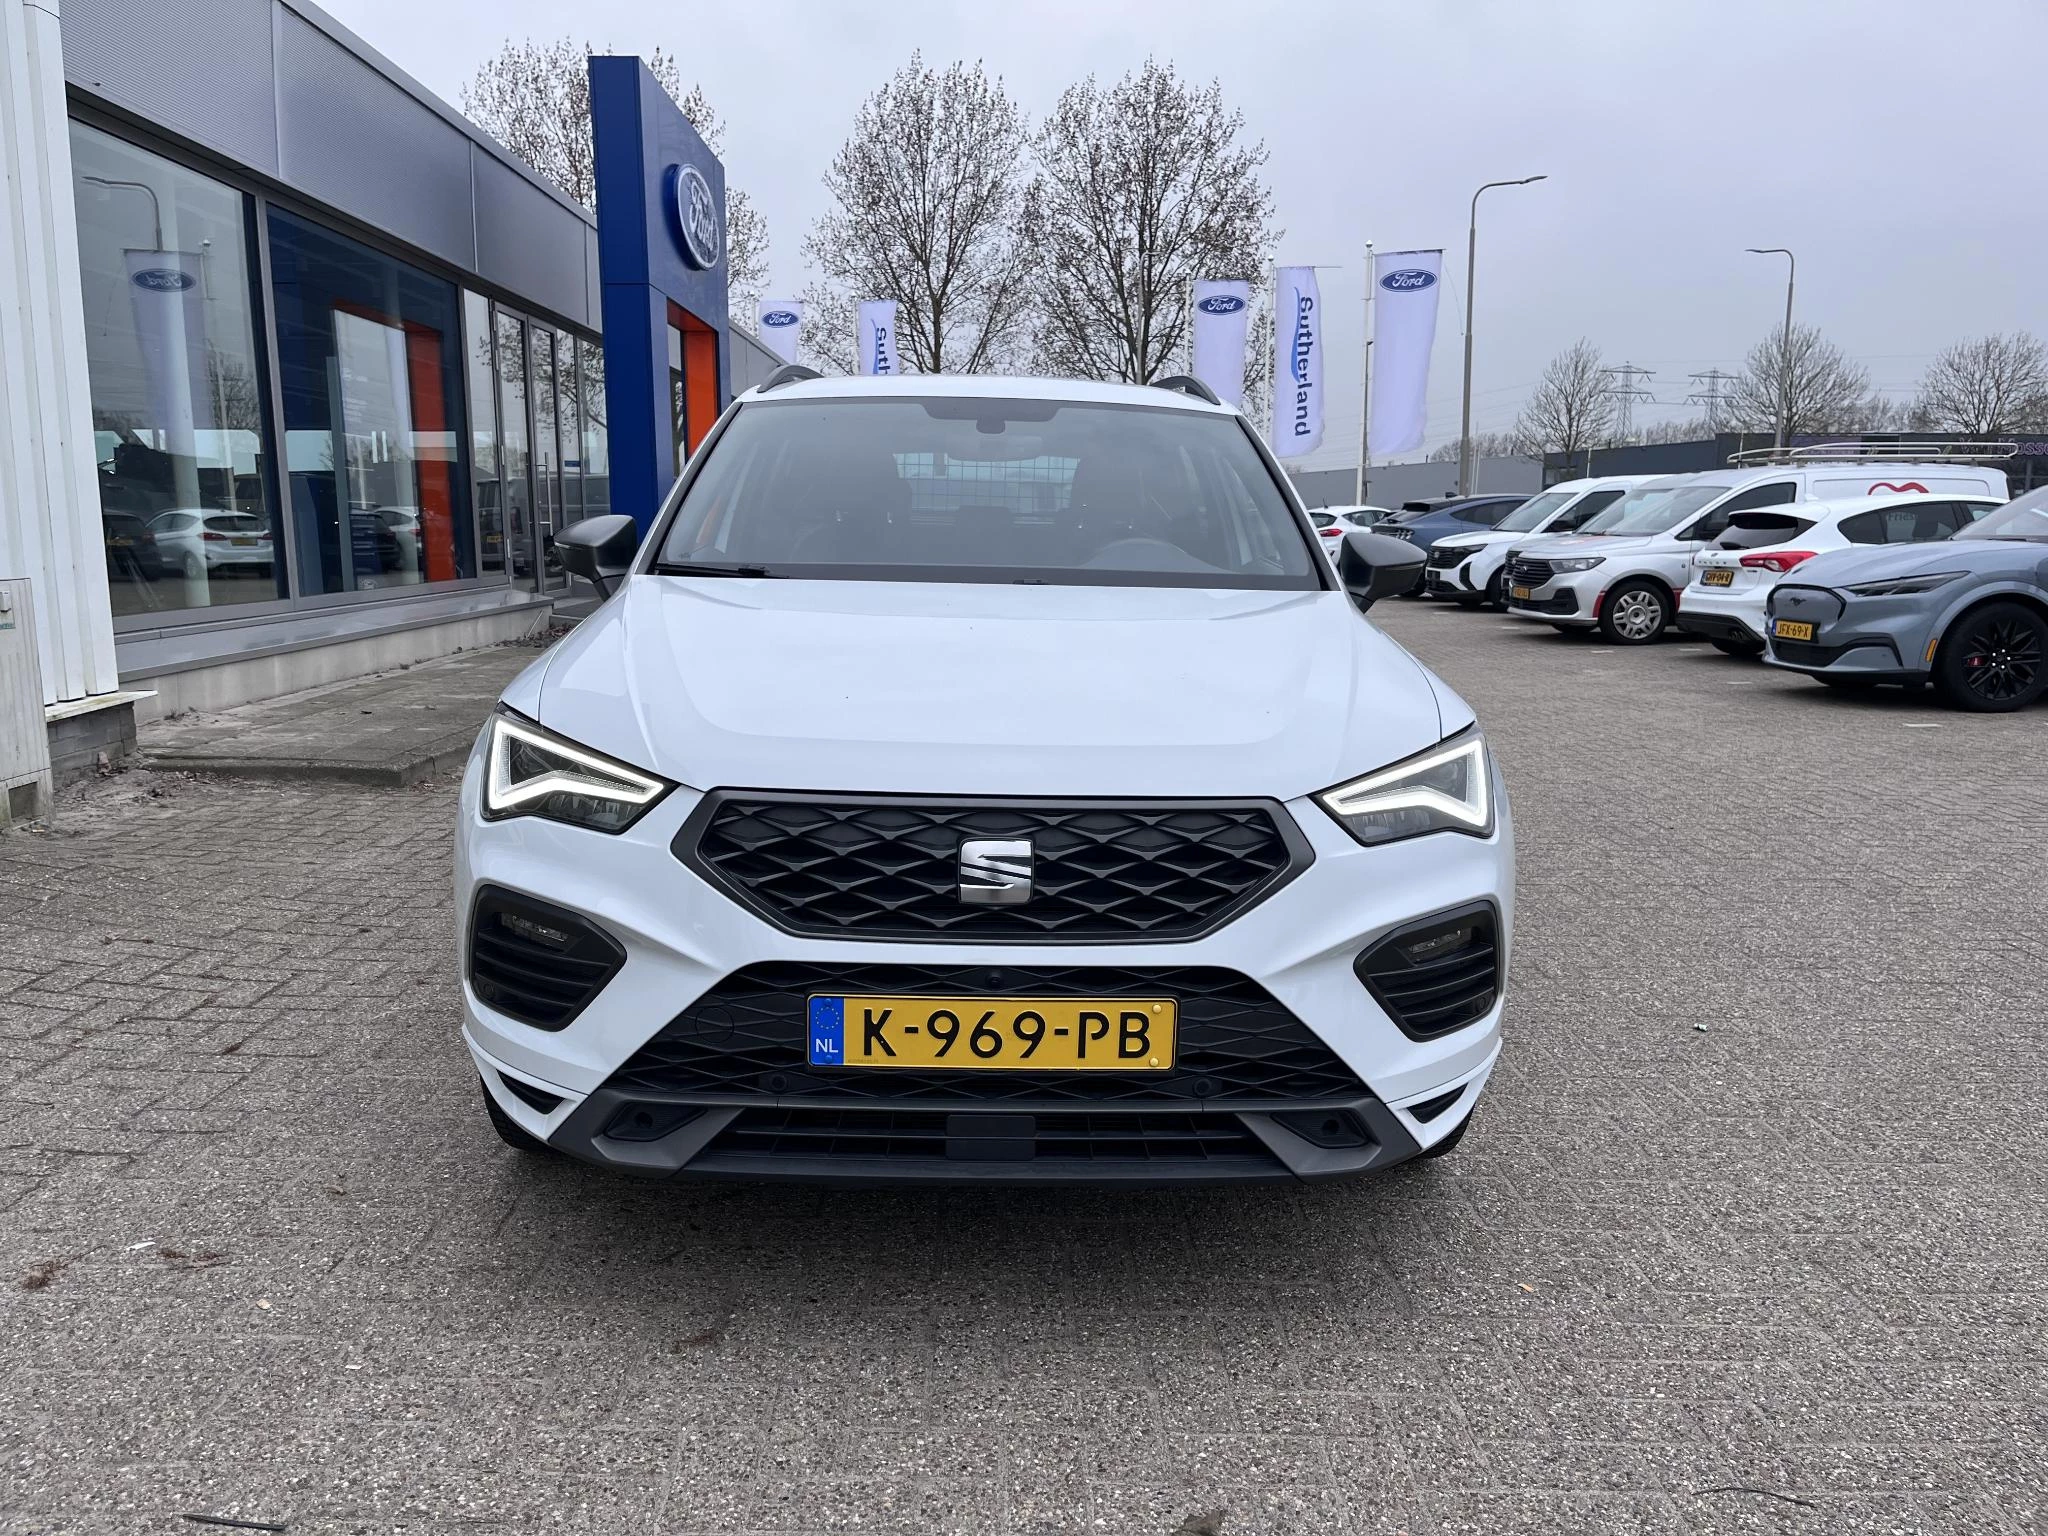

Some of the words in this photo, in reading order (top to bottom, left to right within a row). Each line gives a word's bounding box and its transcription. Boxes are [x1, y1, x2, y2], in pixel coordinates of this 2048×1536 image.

[689, 181, 714, 251] Ford
[1392, 271, 1425, 288] Ford
[1207, 298, 1238, 311] Ford
[768, 312, 791, 324] Ford
[1294, 296, 1314, 437] Sutherland
[1777, 623, 1809, 638] JFX-69-X
[815, 1038, 838, 1053] NL
[863, 1008, 1151, 1059] K-969-PB
